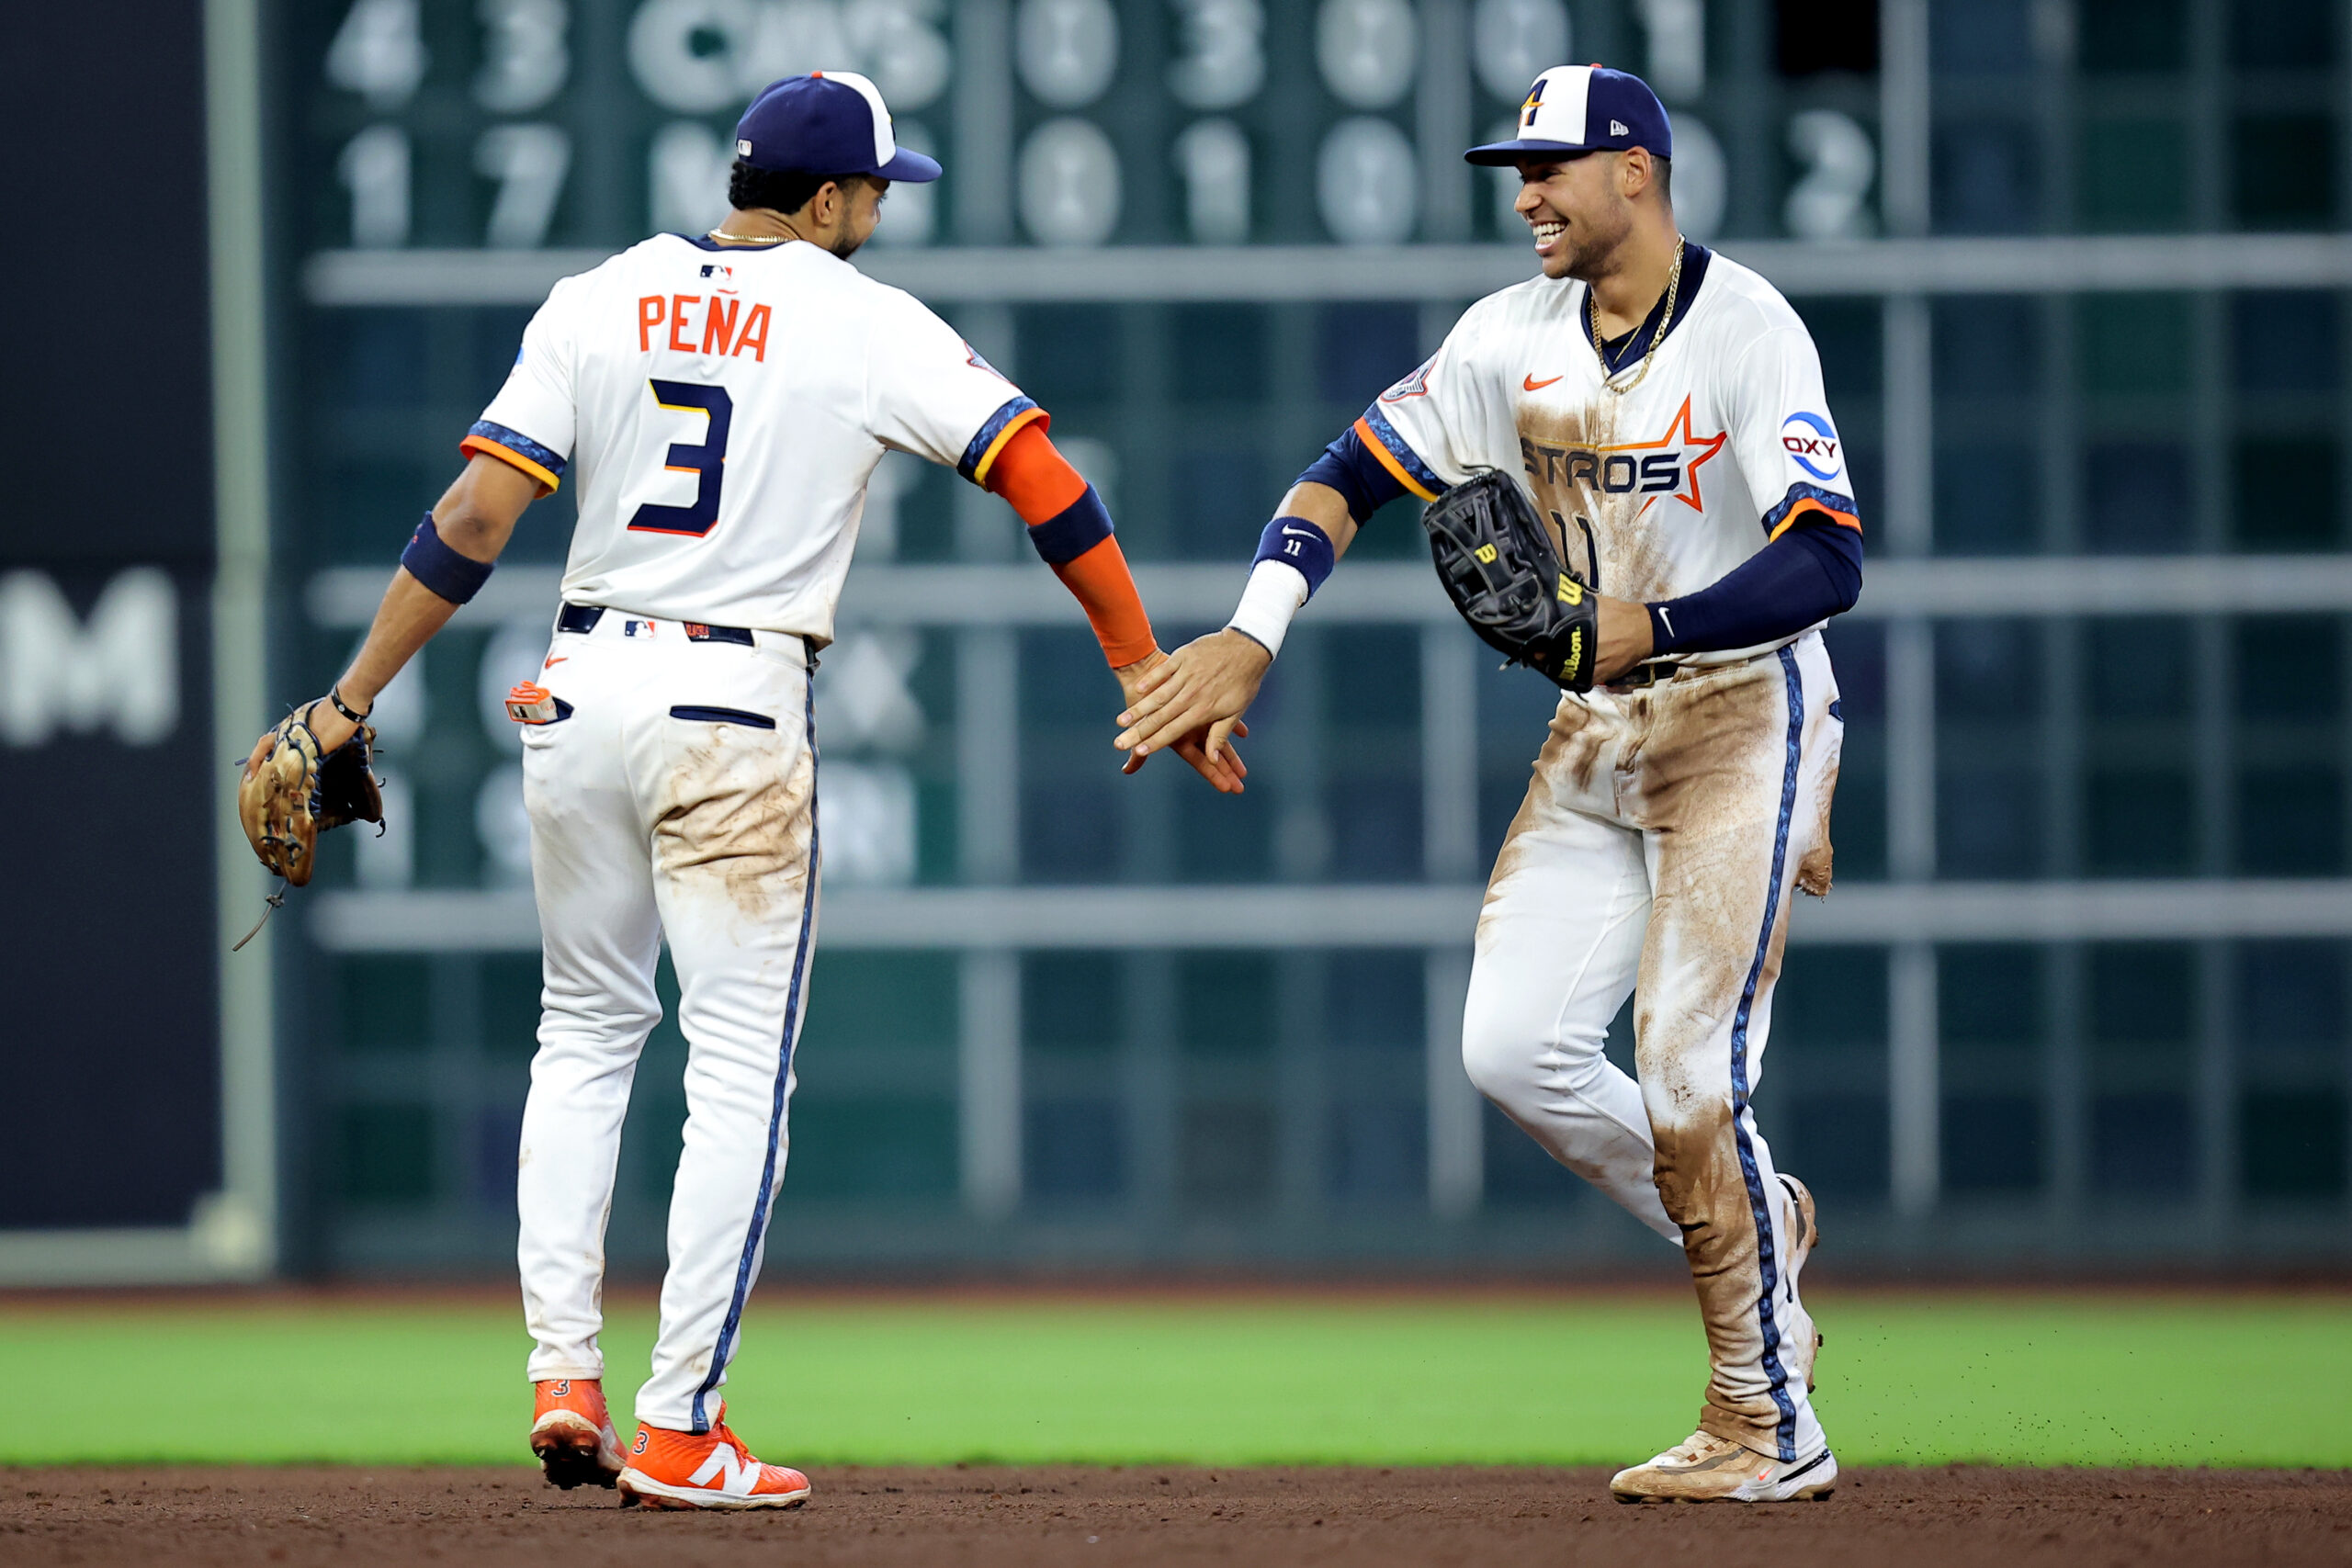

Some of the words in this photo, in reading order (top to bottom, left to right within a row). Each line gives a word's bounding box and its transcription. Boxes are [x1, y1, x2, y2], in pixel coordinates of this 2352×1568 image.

[639, 288, 772, 363] PEÑA
[627, 378, 733, 537] 3
[1782, 436, 1837, 458] OXY
[1283, 538, 1302, 557] 11
[632, 1430, 650, 1455] 3
